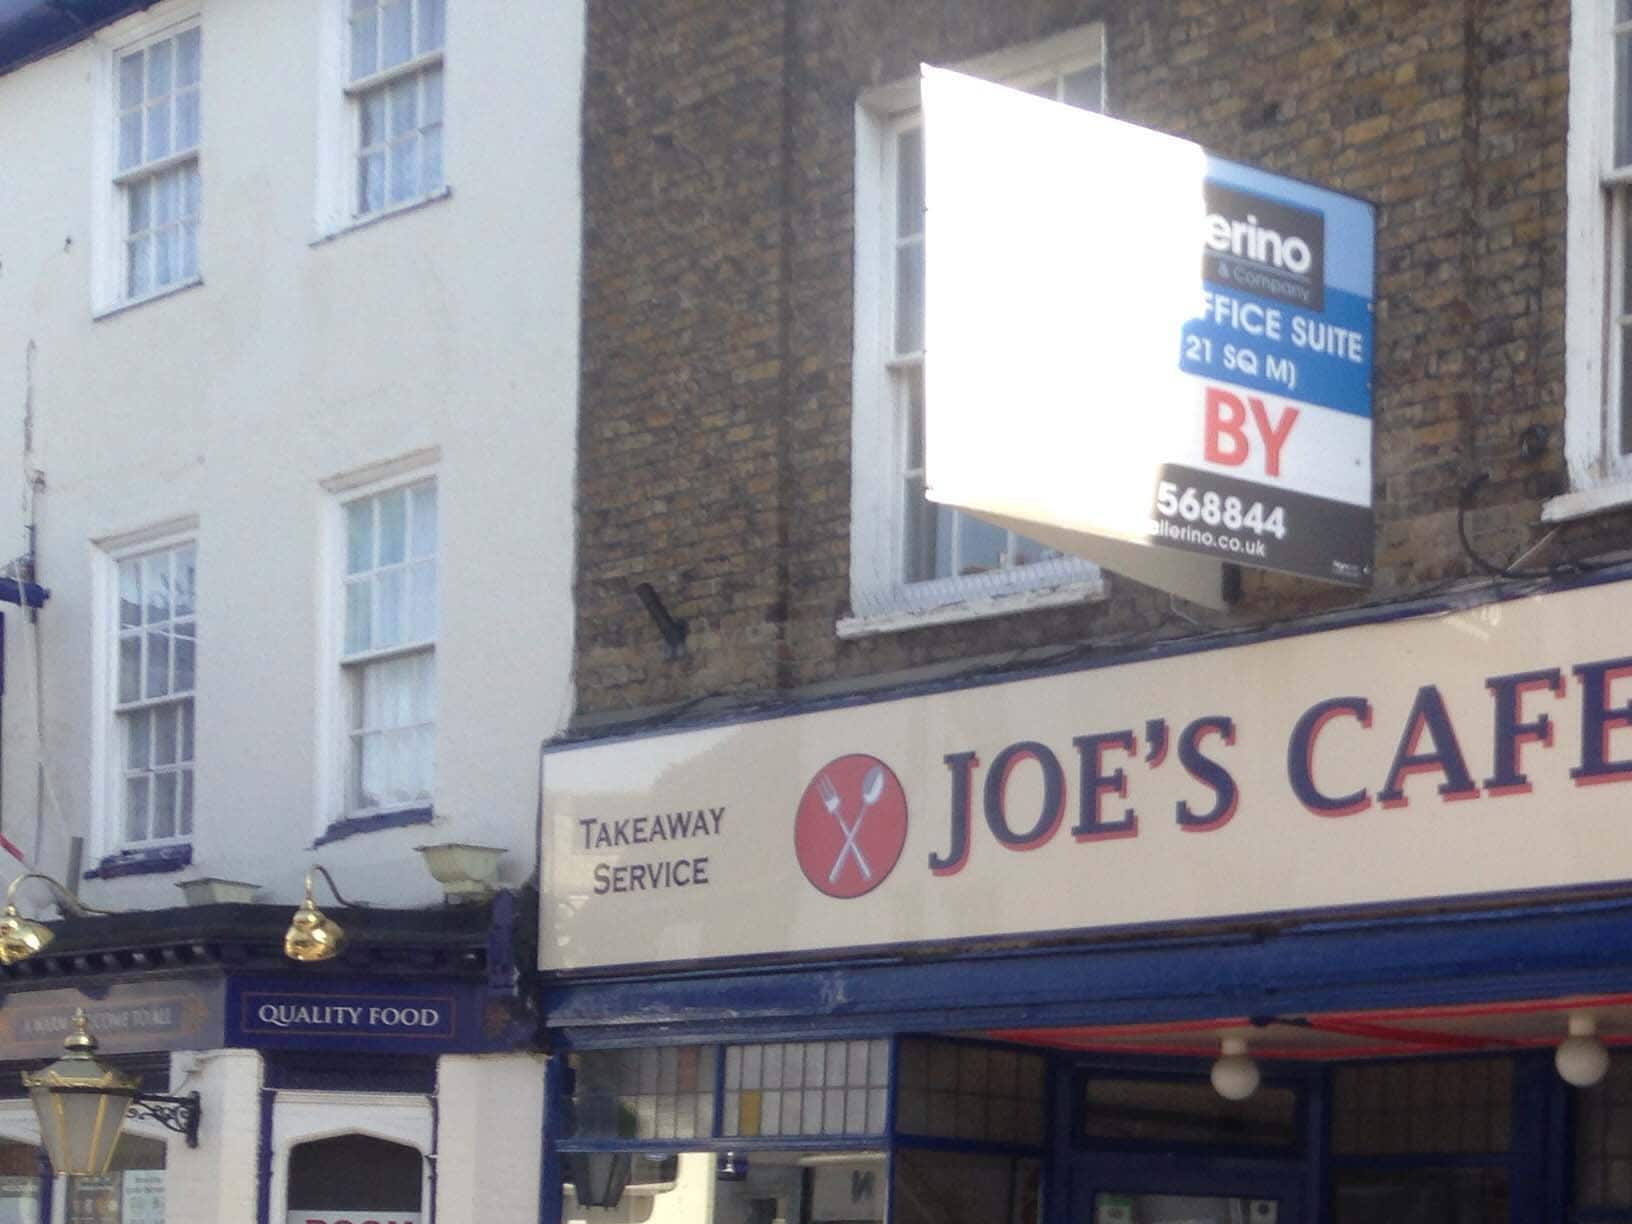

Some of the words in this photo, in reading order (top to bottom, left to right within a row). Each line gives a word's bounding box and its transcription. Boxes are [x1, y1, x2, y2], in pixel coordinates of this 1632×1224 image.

[1291, 316, 1364, 363] SUITE
[1223, 343, 1259, 376] SQ
[1266, 354, 1298, 390] M)
[1204, 387, 1301, 478] BY
[1156, 480, 1287, 540] 568844
[928, 714, 1240, 877] JOE'S
[579, 807, 726, 849] TAKEAWAY
[593, 857, 709, 895] SERVICE
[258, 1004, 363, 1027] QUALITY
[369, 1007, 440, 1026] FOOD
